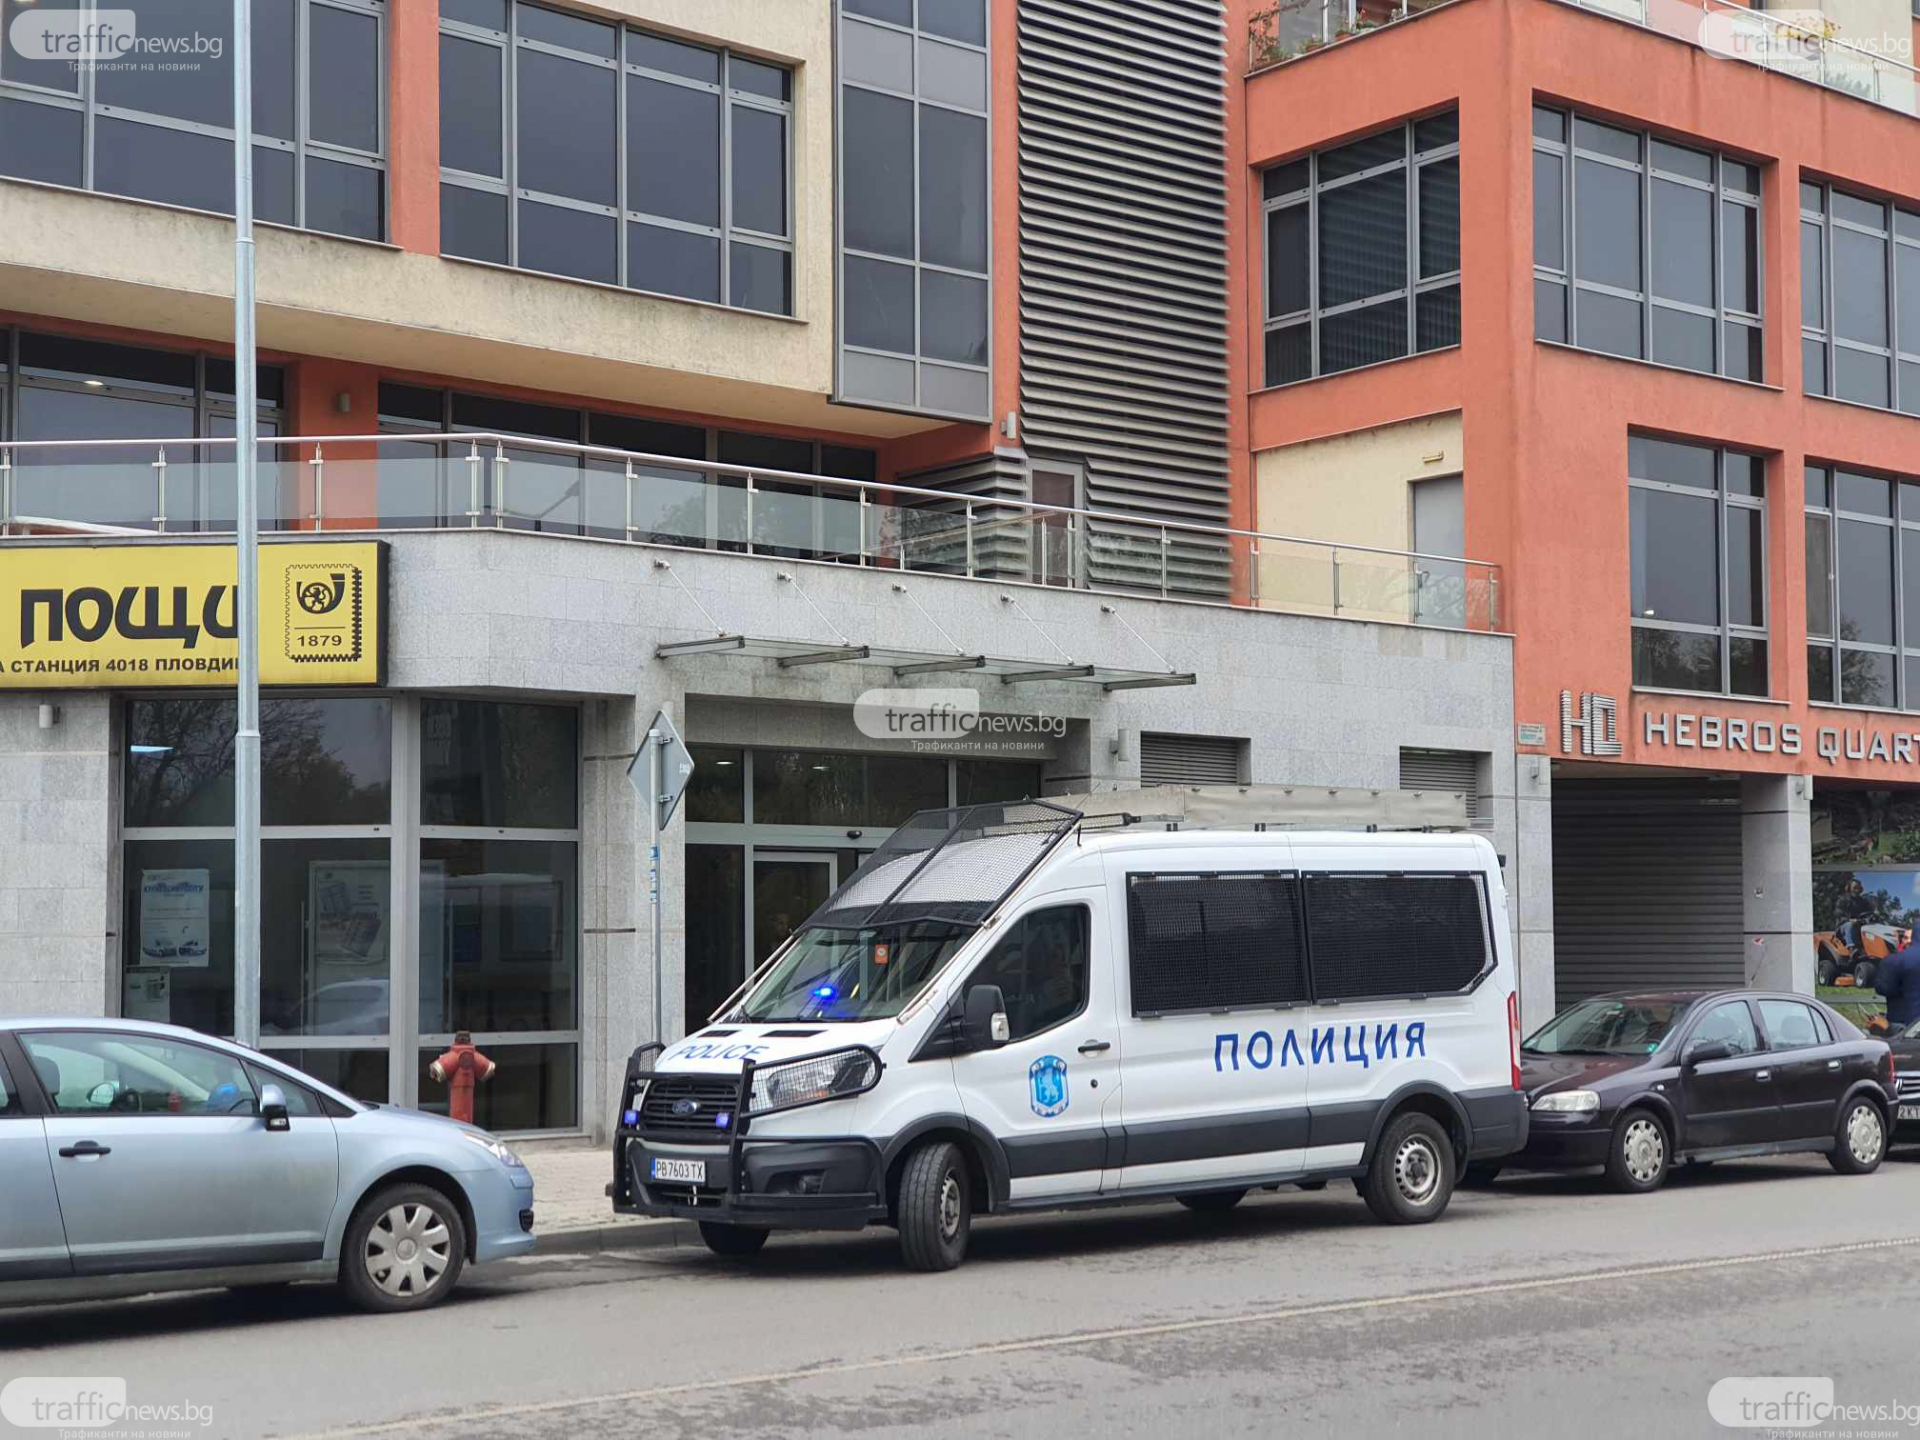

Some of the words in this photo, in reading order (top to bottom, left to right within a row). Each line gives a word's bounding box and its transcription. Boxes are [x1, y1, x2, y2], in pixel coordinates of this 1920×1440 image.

[296, 634, 342, 647] 1879
[11, 659, 100, 675] СТАНЦИЯ
[105, 658, 149, 672] 4018
[155, 657, 238, 673] ПЛОВДИ
[1645, 711, 1800, 754] HEBROS
[667, 1044, 770, 1060] POLICE
[1214, 1022, 1426, 1072] ПОЛИЦИЯ
